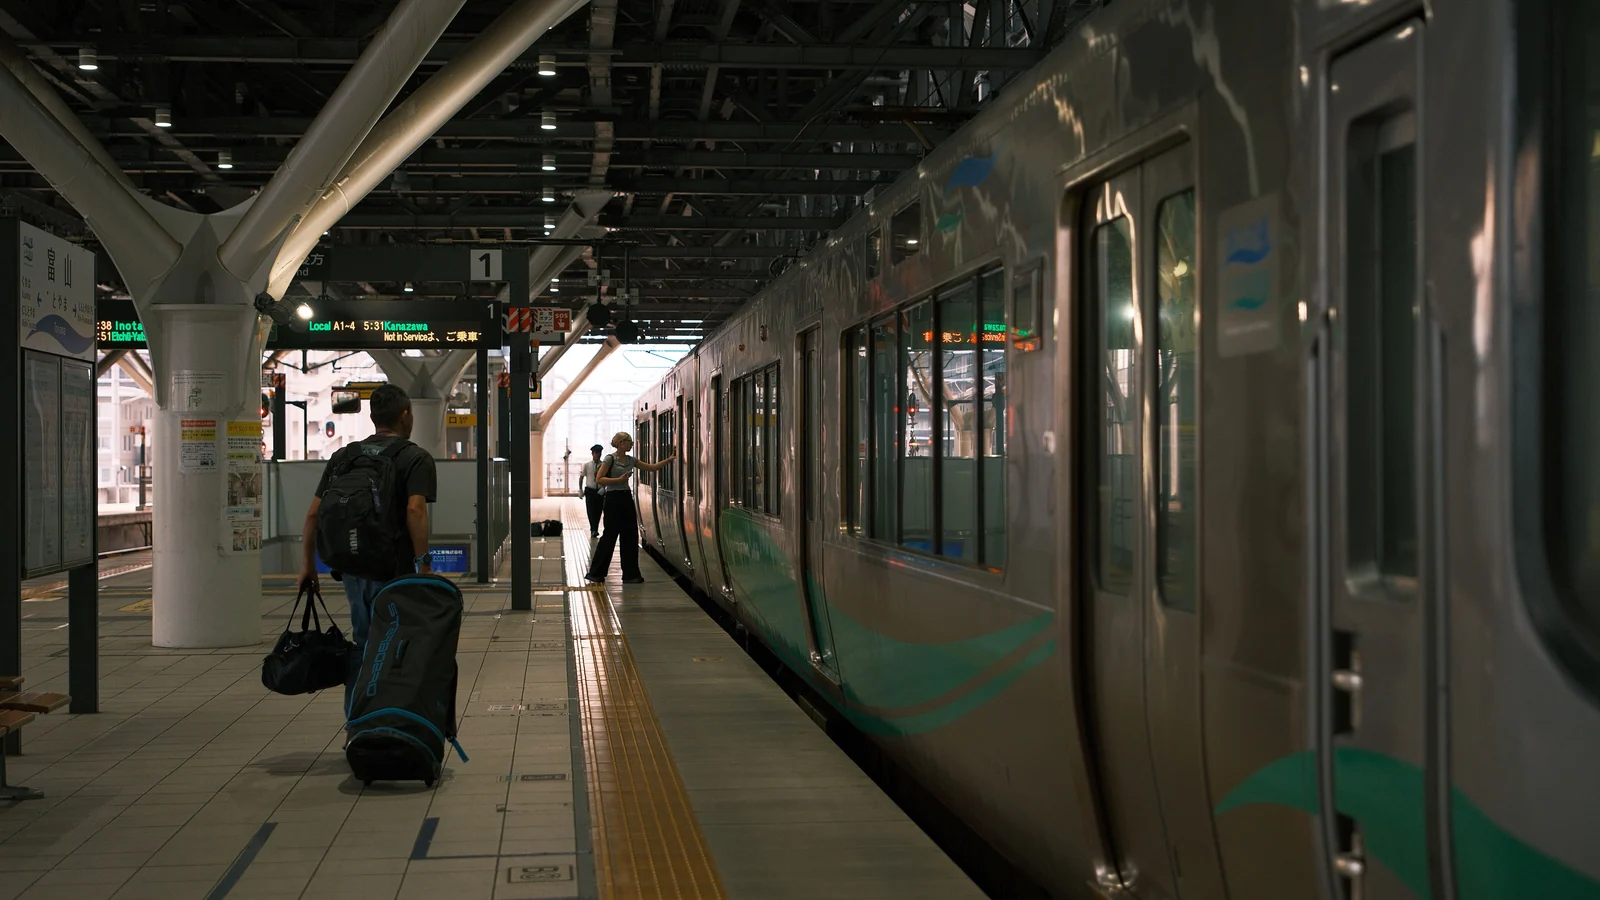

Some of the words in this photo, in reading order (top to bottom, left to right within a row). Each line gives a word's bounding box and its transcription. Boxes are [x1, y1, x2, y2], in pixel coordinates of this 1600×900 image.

[47, 247, 71, 289] 富山
[479, 253, 490, 277] 1
[487, 303, 494, 319] 1
[309, 321, 331, 331] Local
[363, 321, 384, 331] 5:31
[384, 321, 429, 331] Kanazawa
[384, 332, 396, 342] Not
[396, 332, 403, 341] in
